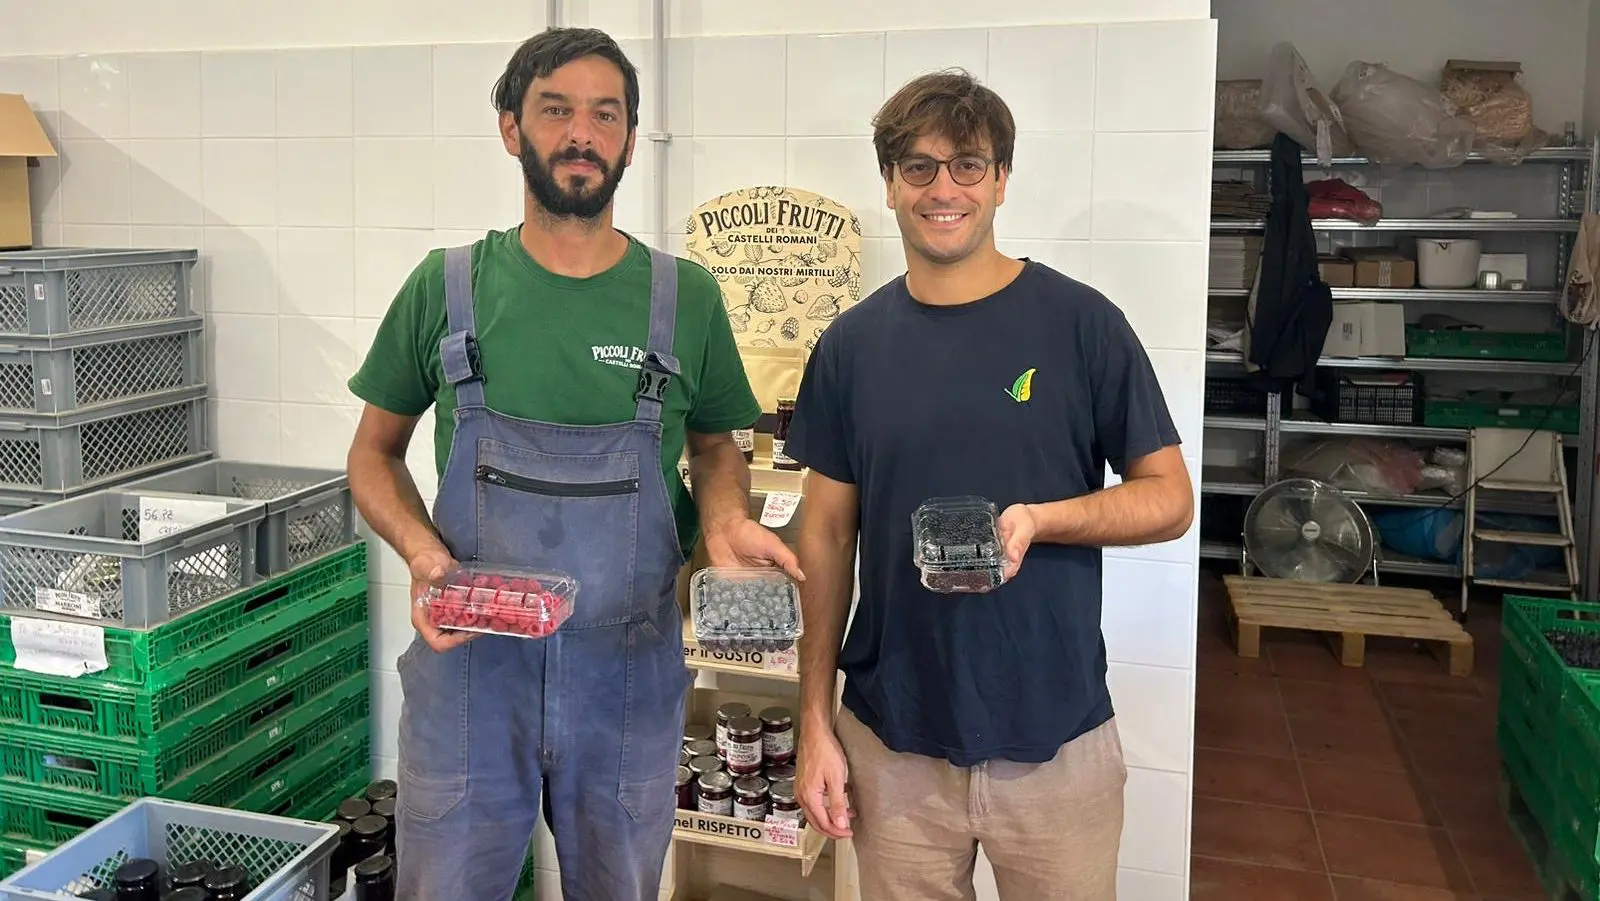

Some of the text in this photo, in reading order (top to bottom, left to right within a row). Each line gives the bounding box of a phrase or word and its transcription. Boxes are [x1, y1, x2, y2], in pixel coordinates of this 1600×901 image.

[699, 200, 846, 240] PICCOLI FRUTTI
[727, 234, 817, 244] CASTELLI ROMANI
[711, 266, 835, 277] SOLO DAI NOSTRI MIRTILLI
[592, 345, 647, 363] PICCOLI FR
[682, 468, 690, 480] P
[683, 647, 697, 656] er
[712, 650, 763, 664] GUSTO
[674, 817, 693, 829] nel
[698, 819, 762, 839] RISPETTO
